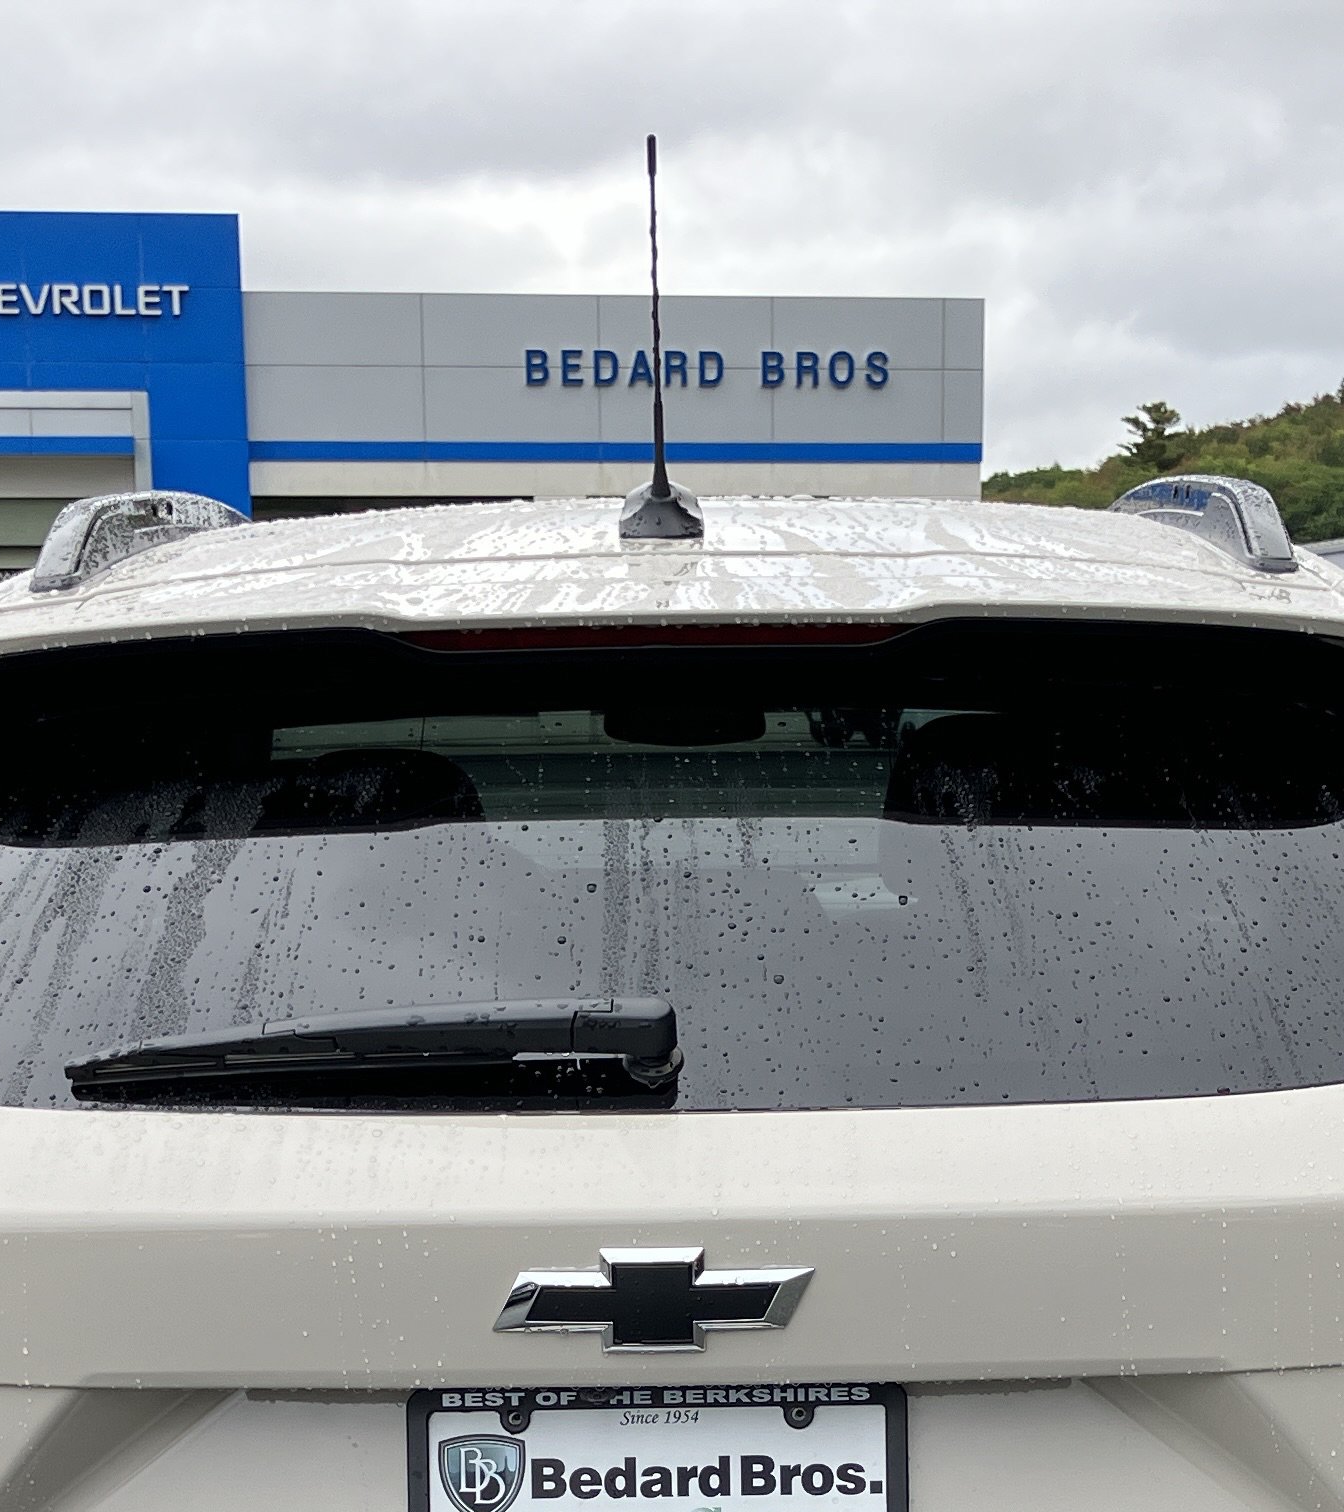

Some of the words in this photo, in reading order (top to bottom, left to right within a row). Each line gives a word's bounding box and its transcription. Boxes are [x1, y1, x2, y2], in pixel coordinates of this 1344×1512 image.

[524, 349, 725, 388] BEDARD
[760, 350, 890, 389] BROS
[441, 1391, 526, 1408] BEST
[535, 1391, 578, 1407] OF
[596, 1390, 653, 1405] HE
[663, 1386, 871, 1405] BERKSHIRES
[620, 1409, 660, 1426] Since
[664, 1408, 700, 1425] 1954
[530, 1455, 731, 1500] Bedard
[740, 1454, 884, 1497] Bros.
